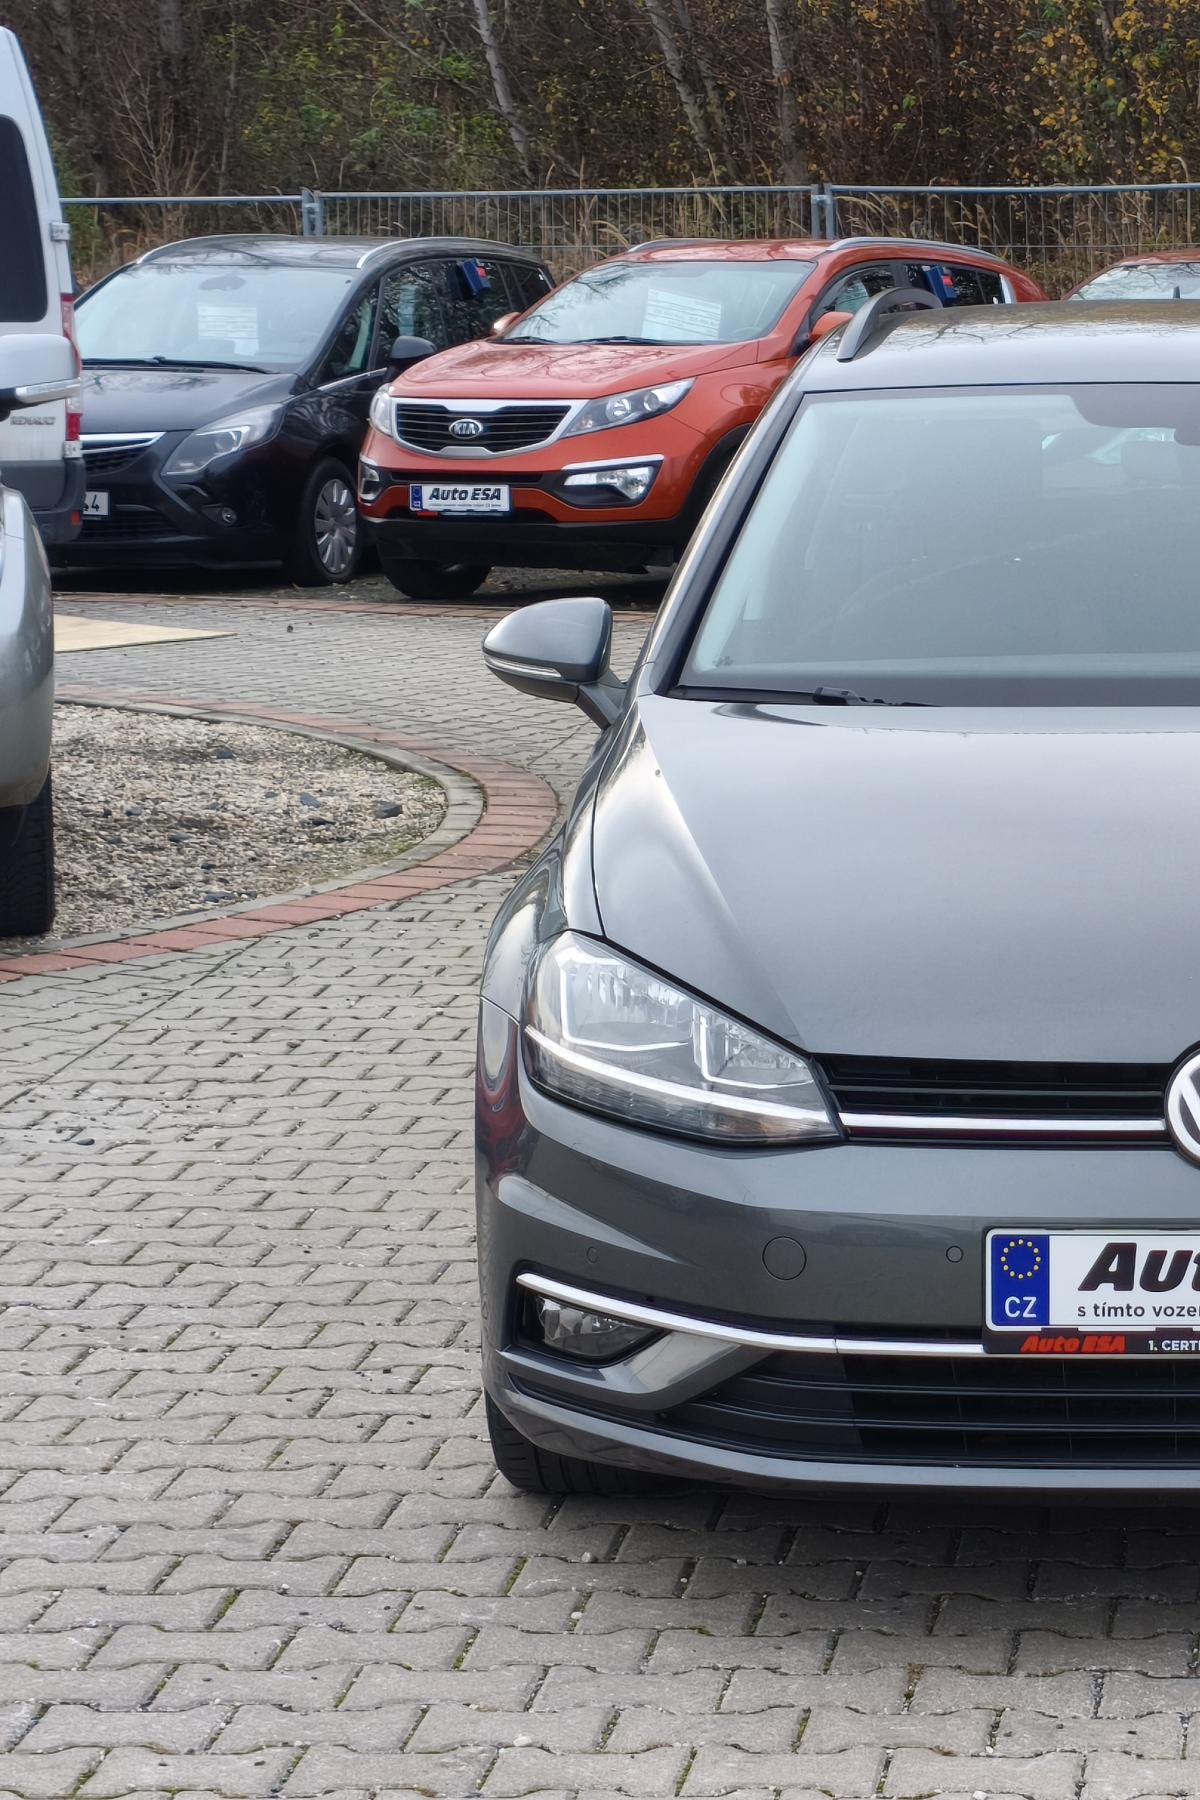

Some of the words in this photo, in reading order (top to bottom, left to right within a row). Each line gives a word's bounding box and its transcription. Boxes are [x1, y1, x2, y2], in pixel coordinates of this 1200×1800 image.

[453, 423, 476, 434] KIA
[429, 488, 468, 500] Auto
[471, 488, 501, 500] ESA
[1004, 1296, 1037, 1318] CZ
[1077, 1304, 1086, 1317] s
[1093, 1302, 1145, 1317] tímto
[1020, 1335, 1080, 1352] Auto
[1081, 1335, 1126, 1352] ESA
[1148, 1340, 1158, 1351] 1.
